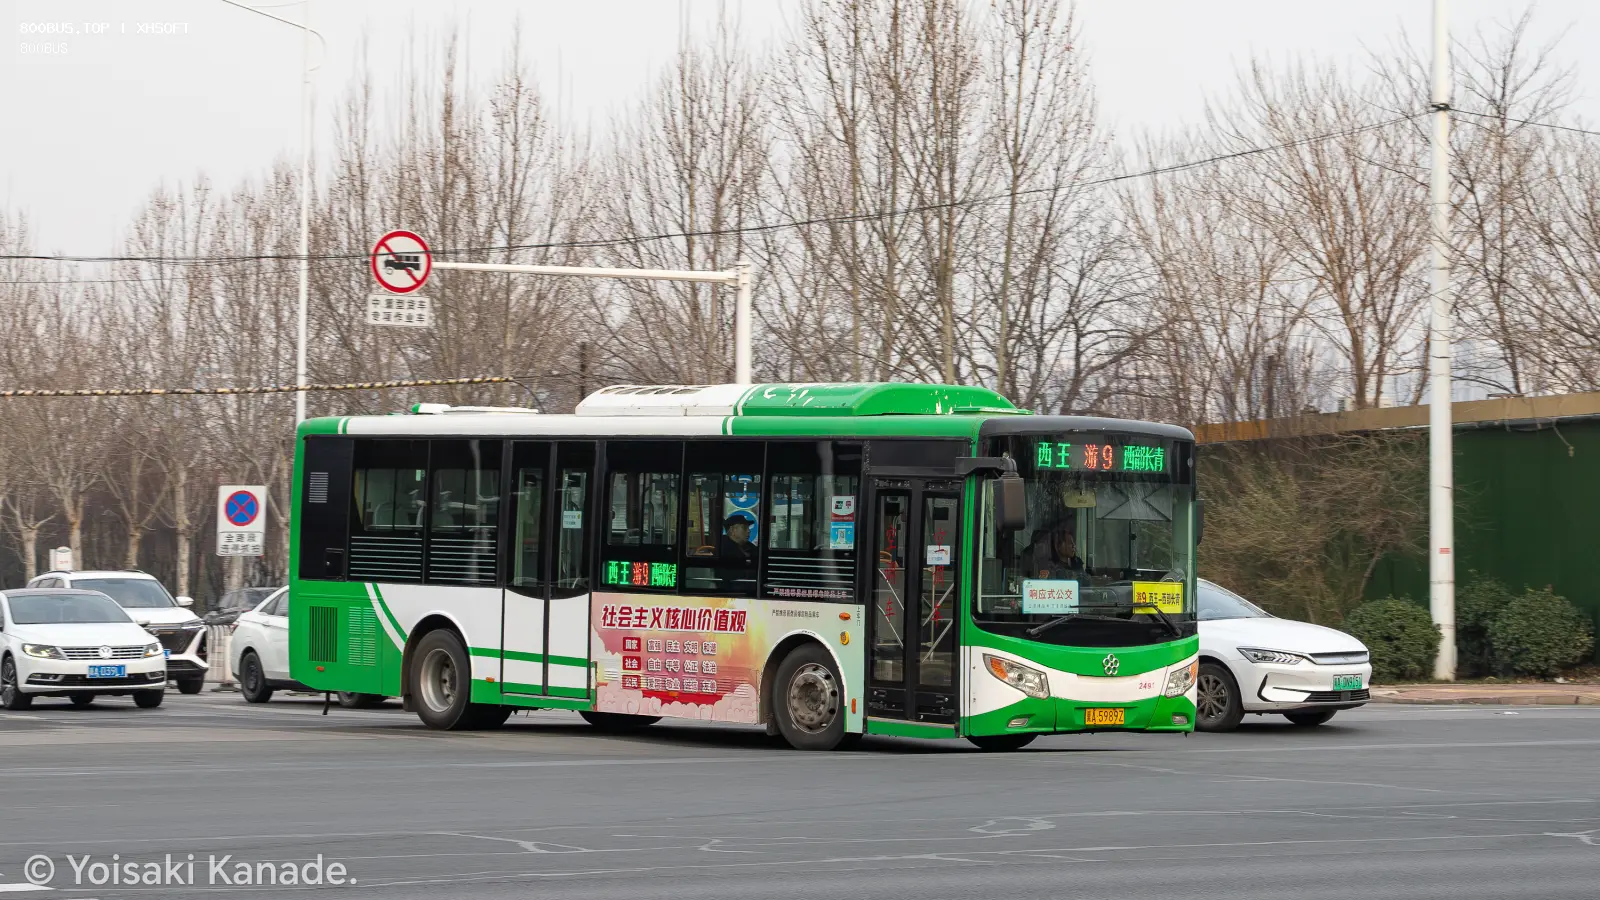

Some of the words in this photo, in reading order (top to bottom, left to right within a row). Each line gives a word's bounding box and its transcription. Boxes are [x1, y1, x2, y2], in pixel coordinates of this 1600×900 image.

[1038, 442, 1071, 468] 西王
[1084, 443, 1113, 469] 游9
[1123, 445, 1165, 472] 西部长青
[608, 561, 630, 585] 西王
[1029, 588, 1073, 600] 响应式公交
[601, 604, 748, 634] 社会主义核心价值观
[625, 639, 638, 650] 国家
[647, 639, 662, 652] 富强
[665, 640, 680, 653] 民主
[683, 640, 698, 654] 文明
[625, 658, 638, 669] 社会
[647, 658, 662, 671] 自由
[665, 659, 680, 672] 平等
[683, 660, 698, 673] 公正
[702, 660, 717, 674] 法治
[625, 678, 638, 688] 公民
